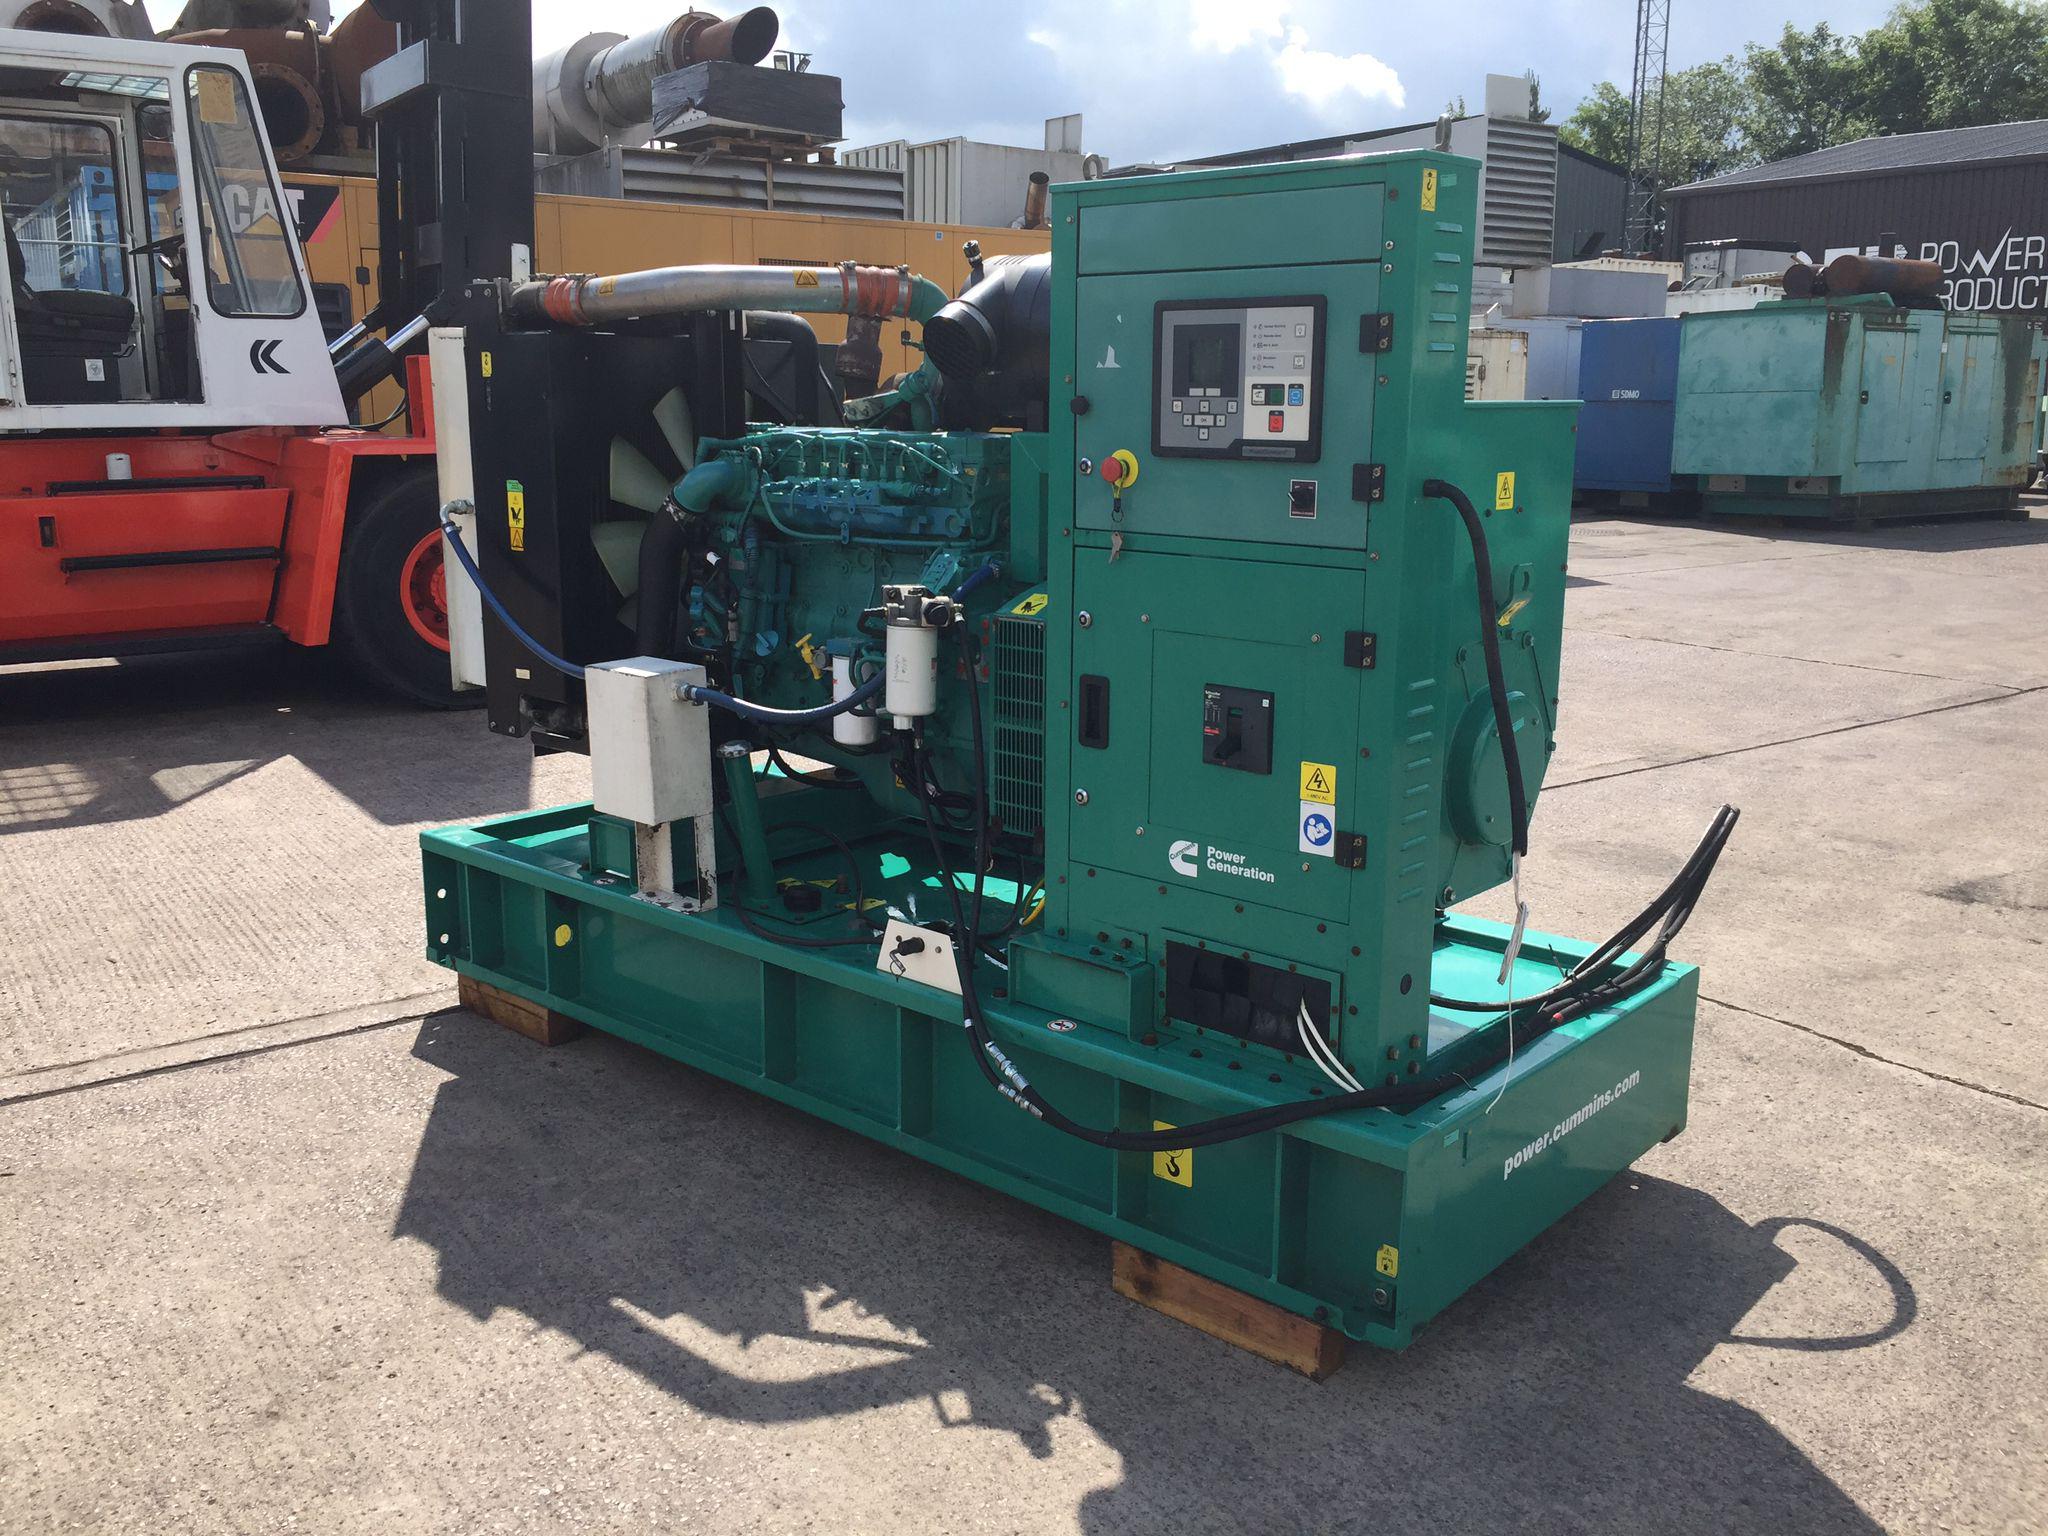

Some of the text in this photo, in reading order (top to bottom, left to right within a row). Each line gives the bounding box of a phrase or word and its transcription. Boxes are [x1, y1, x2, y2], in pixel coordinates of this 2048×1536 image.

[1920, 226, 2046, 276] POWER
[1938, 275, 2048, 311] RODUCT
[1620, 389, 1640, 399] SDMO
[1169, 842, 1196, 860] Cummins
[1207, 845, 1246, 864] Power
[1206, 857, 1275, 883] Generation
[1503, 1069, 1641, 1182] power.cummins.com
